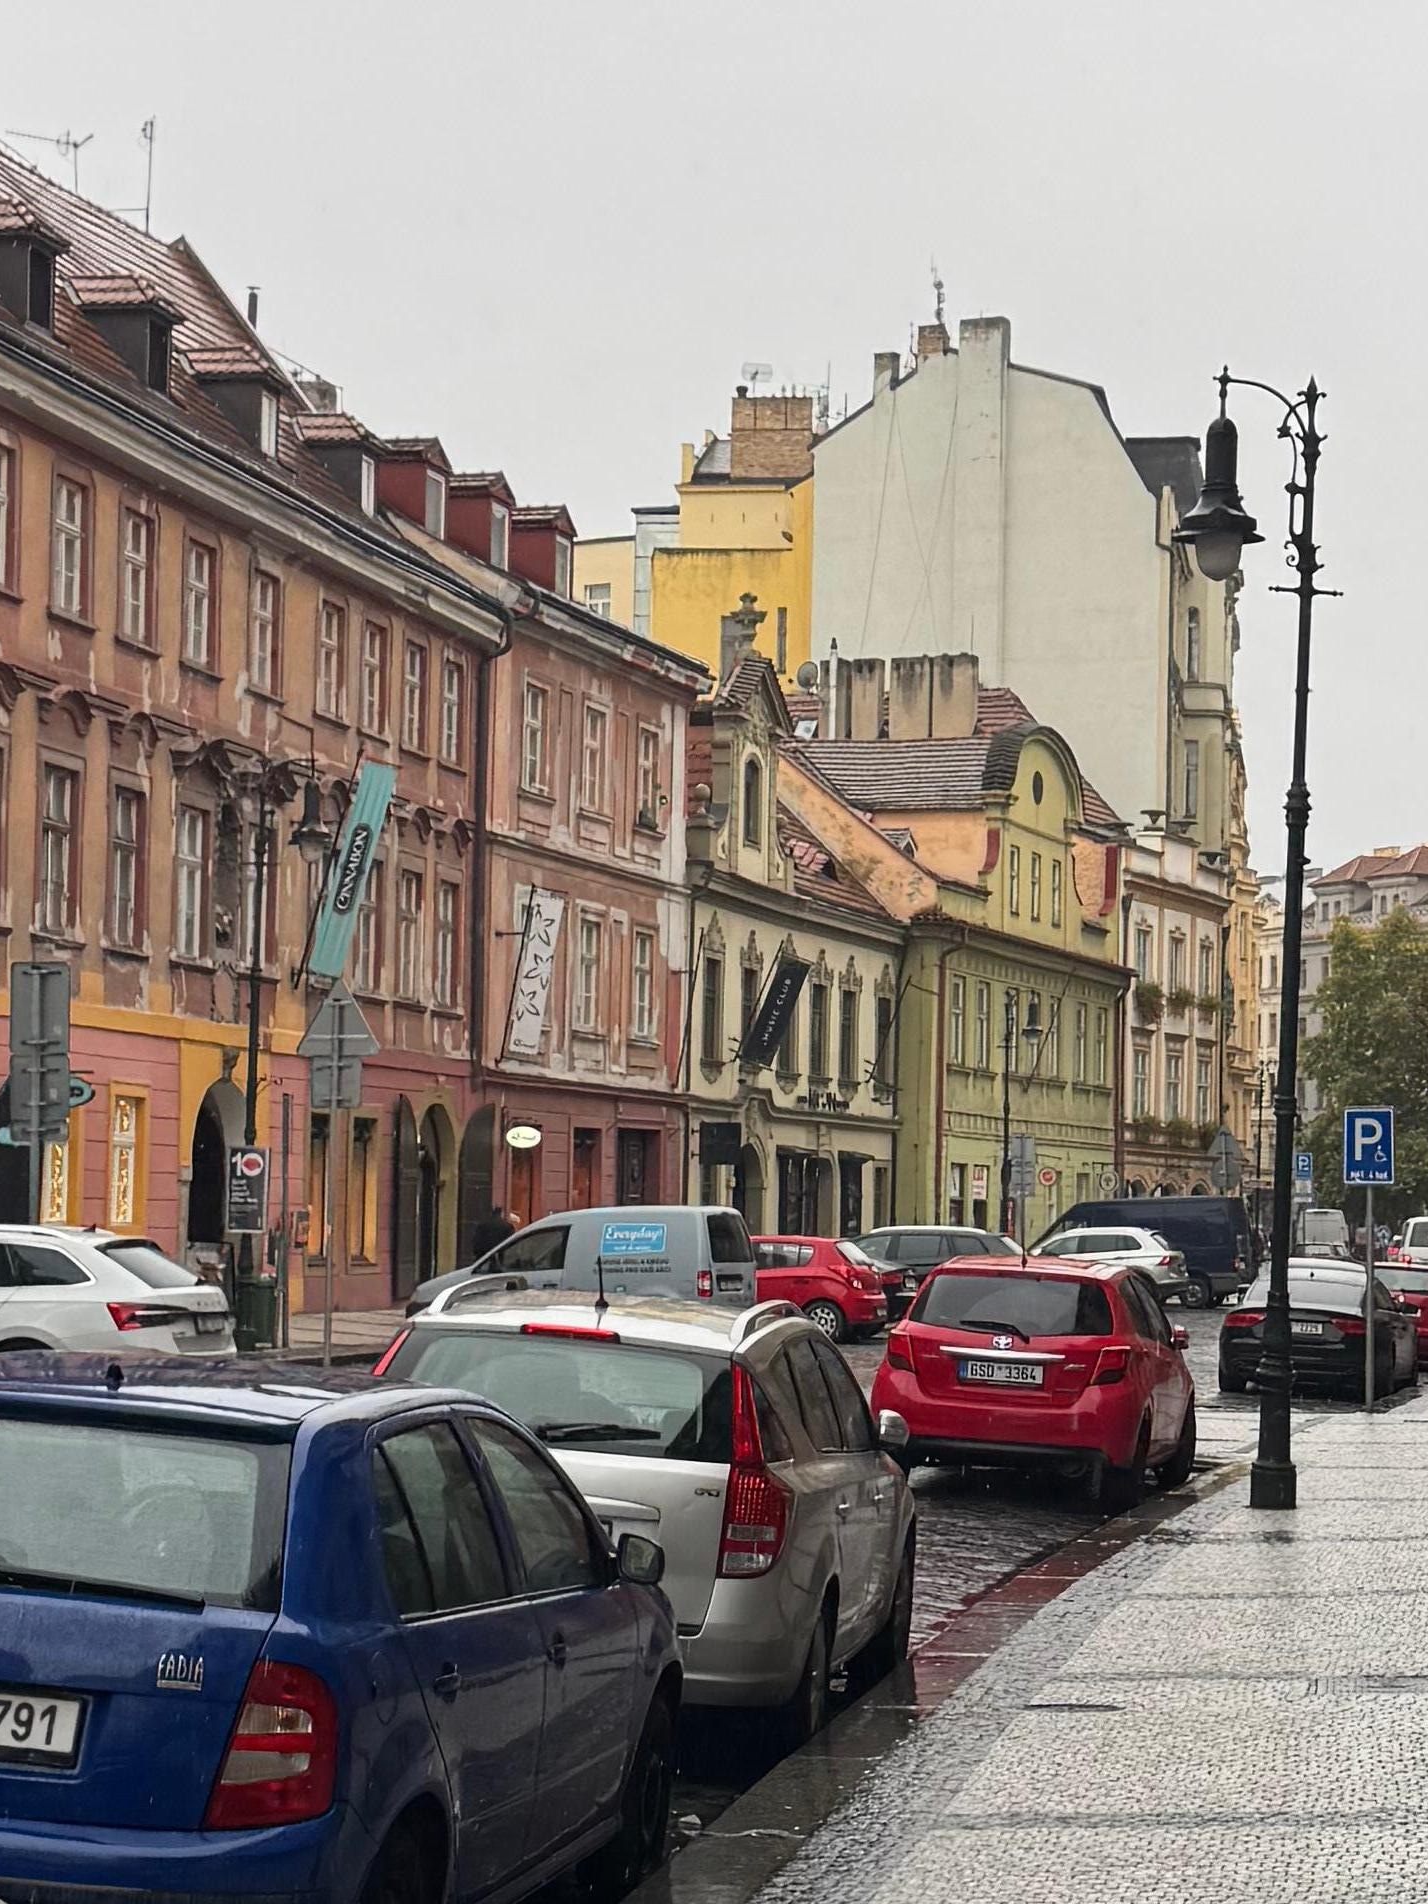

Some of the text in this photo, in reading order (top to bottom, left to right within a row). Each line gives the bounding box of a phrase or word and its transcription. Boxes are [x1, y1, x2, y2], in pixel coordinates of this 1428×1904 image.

[336, 828, 368, 910] CINNABON
[1355, 1118, 1383, 1161] P
[1004, 1365, 1036, 1381] 3364
